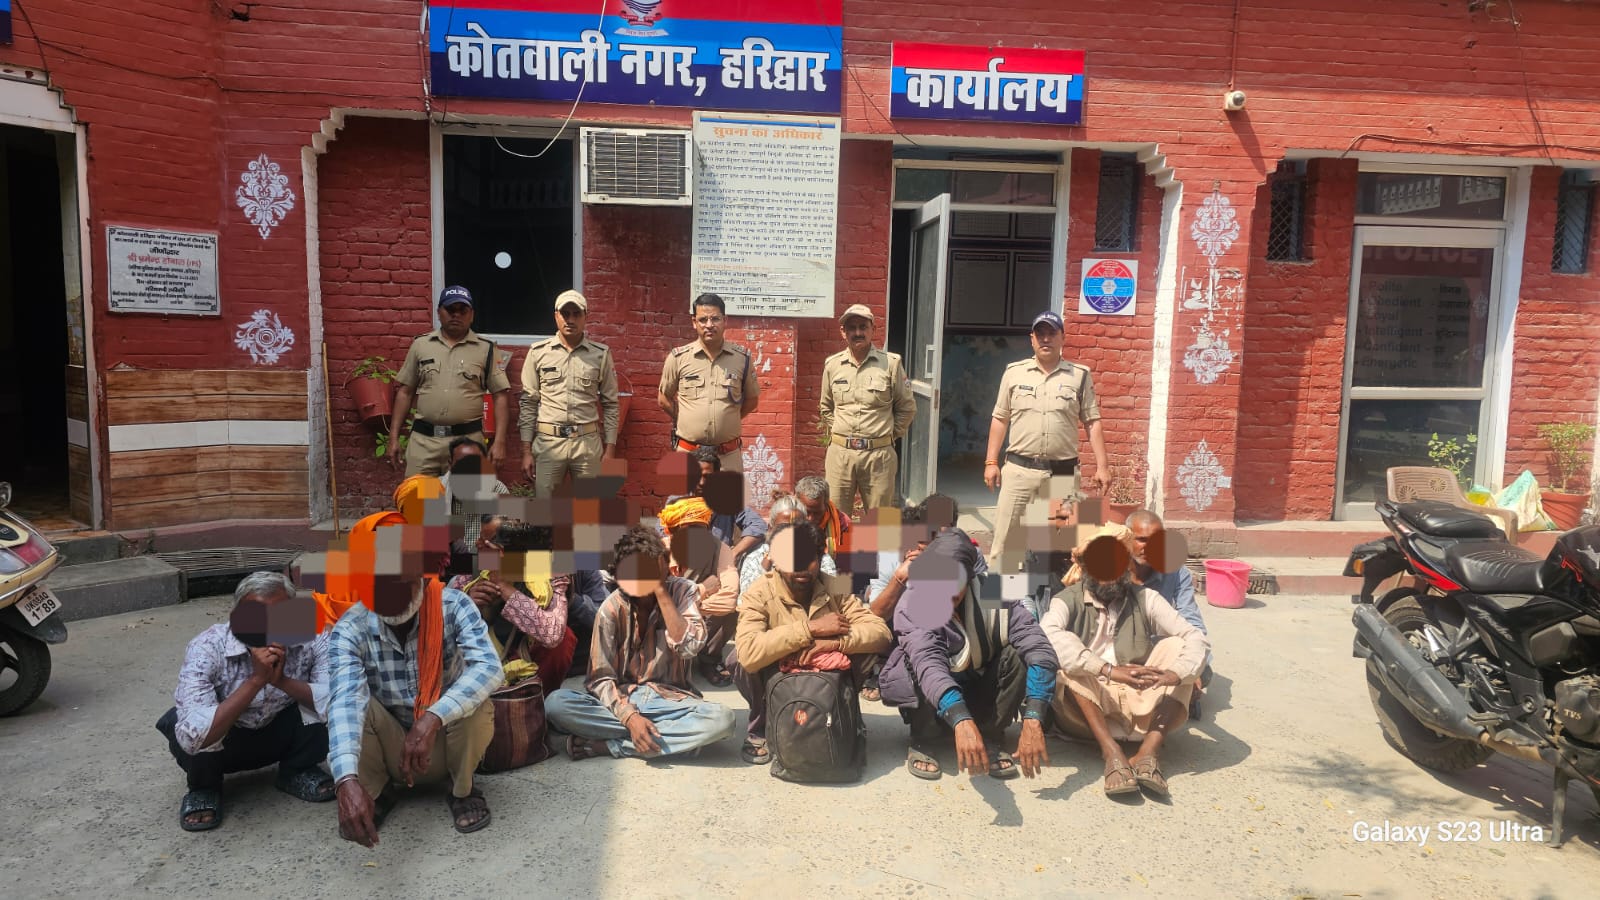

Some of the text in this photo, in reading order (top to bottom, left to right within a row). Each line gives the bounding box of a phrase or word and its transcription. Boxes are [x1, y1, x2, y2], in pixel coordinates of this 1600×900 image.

[446, 22, 830, 97] कोतवाली नगर, हरिद्वार
[905, 57, 1073, 113] कार्यालय
[751, 128, 768, 138] का
[772, 128, 824, 141] अधिकार
[1564, 708, 1582, 720] TVS
